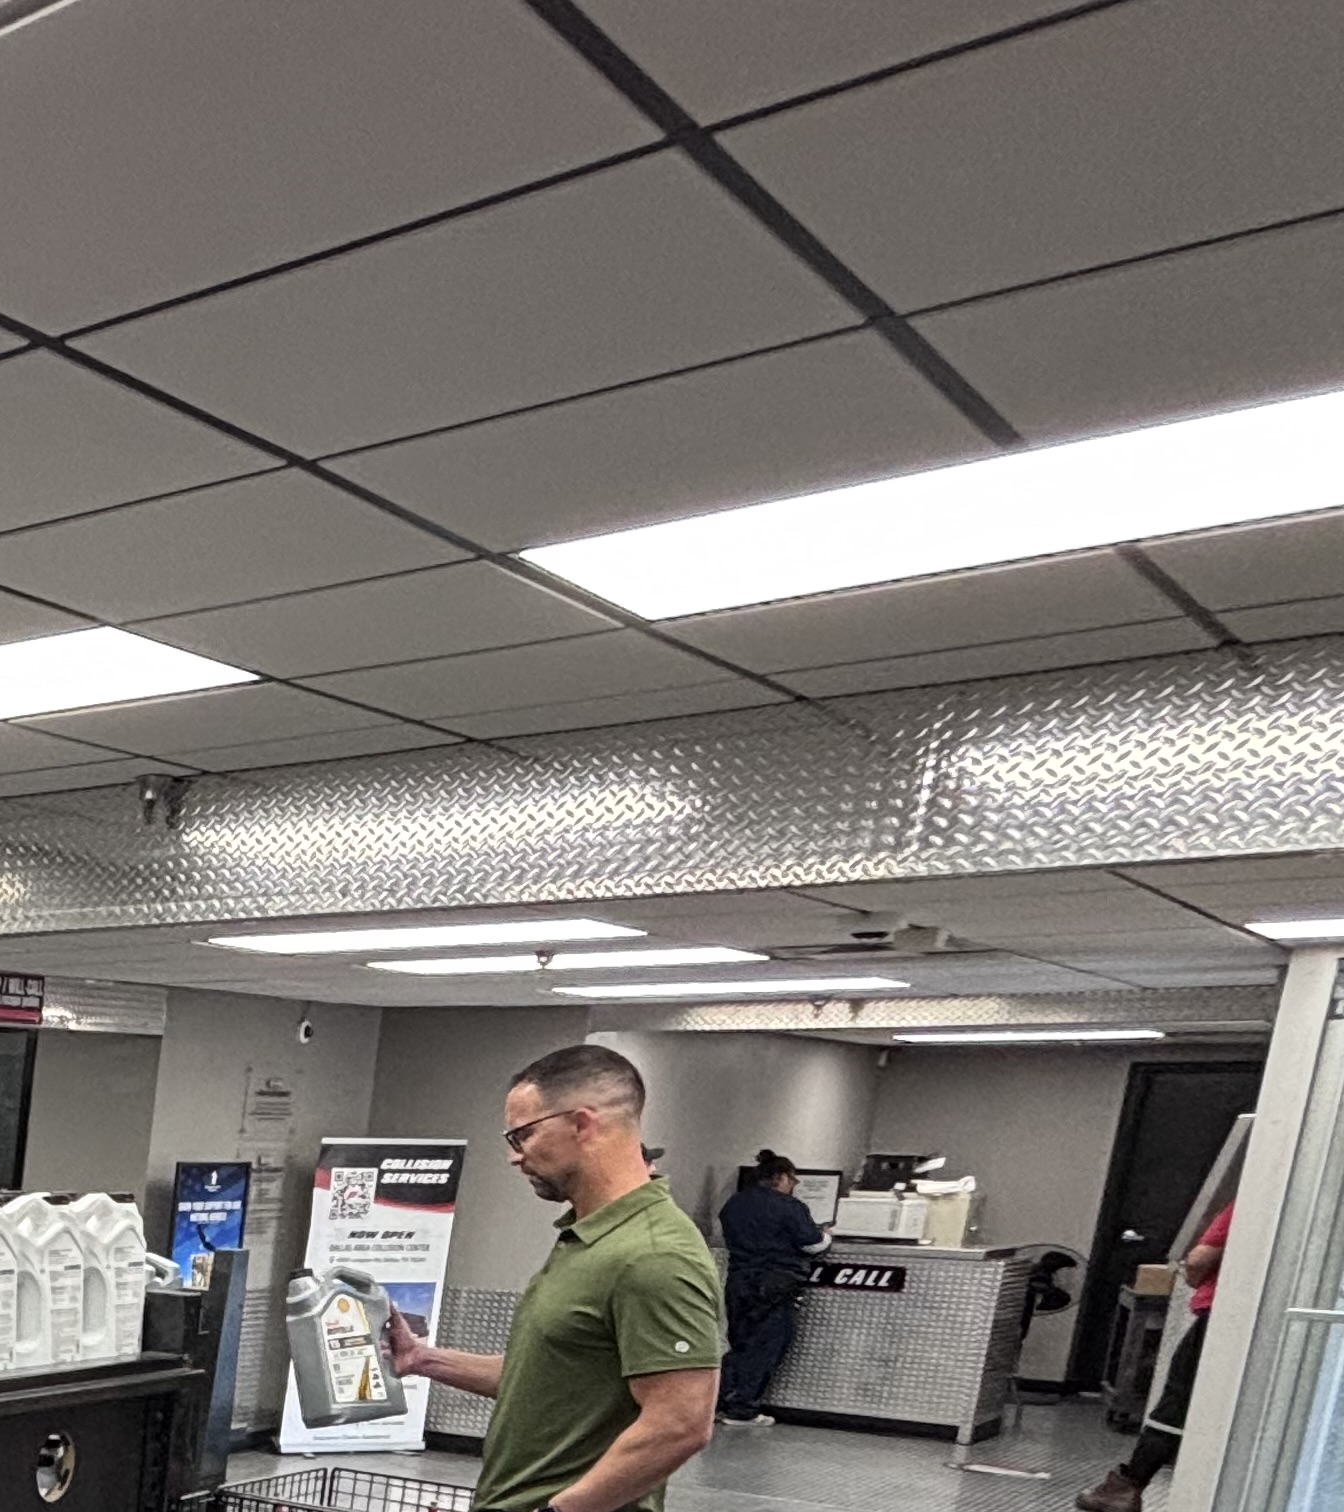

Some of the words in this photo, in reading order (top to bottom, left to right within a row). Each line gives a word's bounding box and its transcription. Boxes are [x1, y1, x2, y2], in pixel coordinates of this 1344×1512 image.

[380, 1159, 453, 1170] COLLISION
[380, 1173, 450, 1184] SERVICES
[348, 1231, 379, 1240] NOW
[381, 1231, 416, 1240] OPEN
[834, 1268, 892, 1287] CALL
